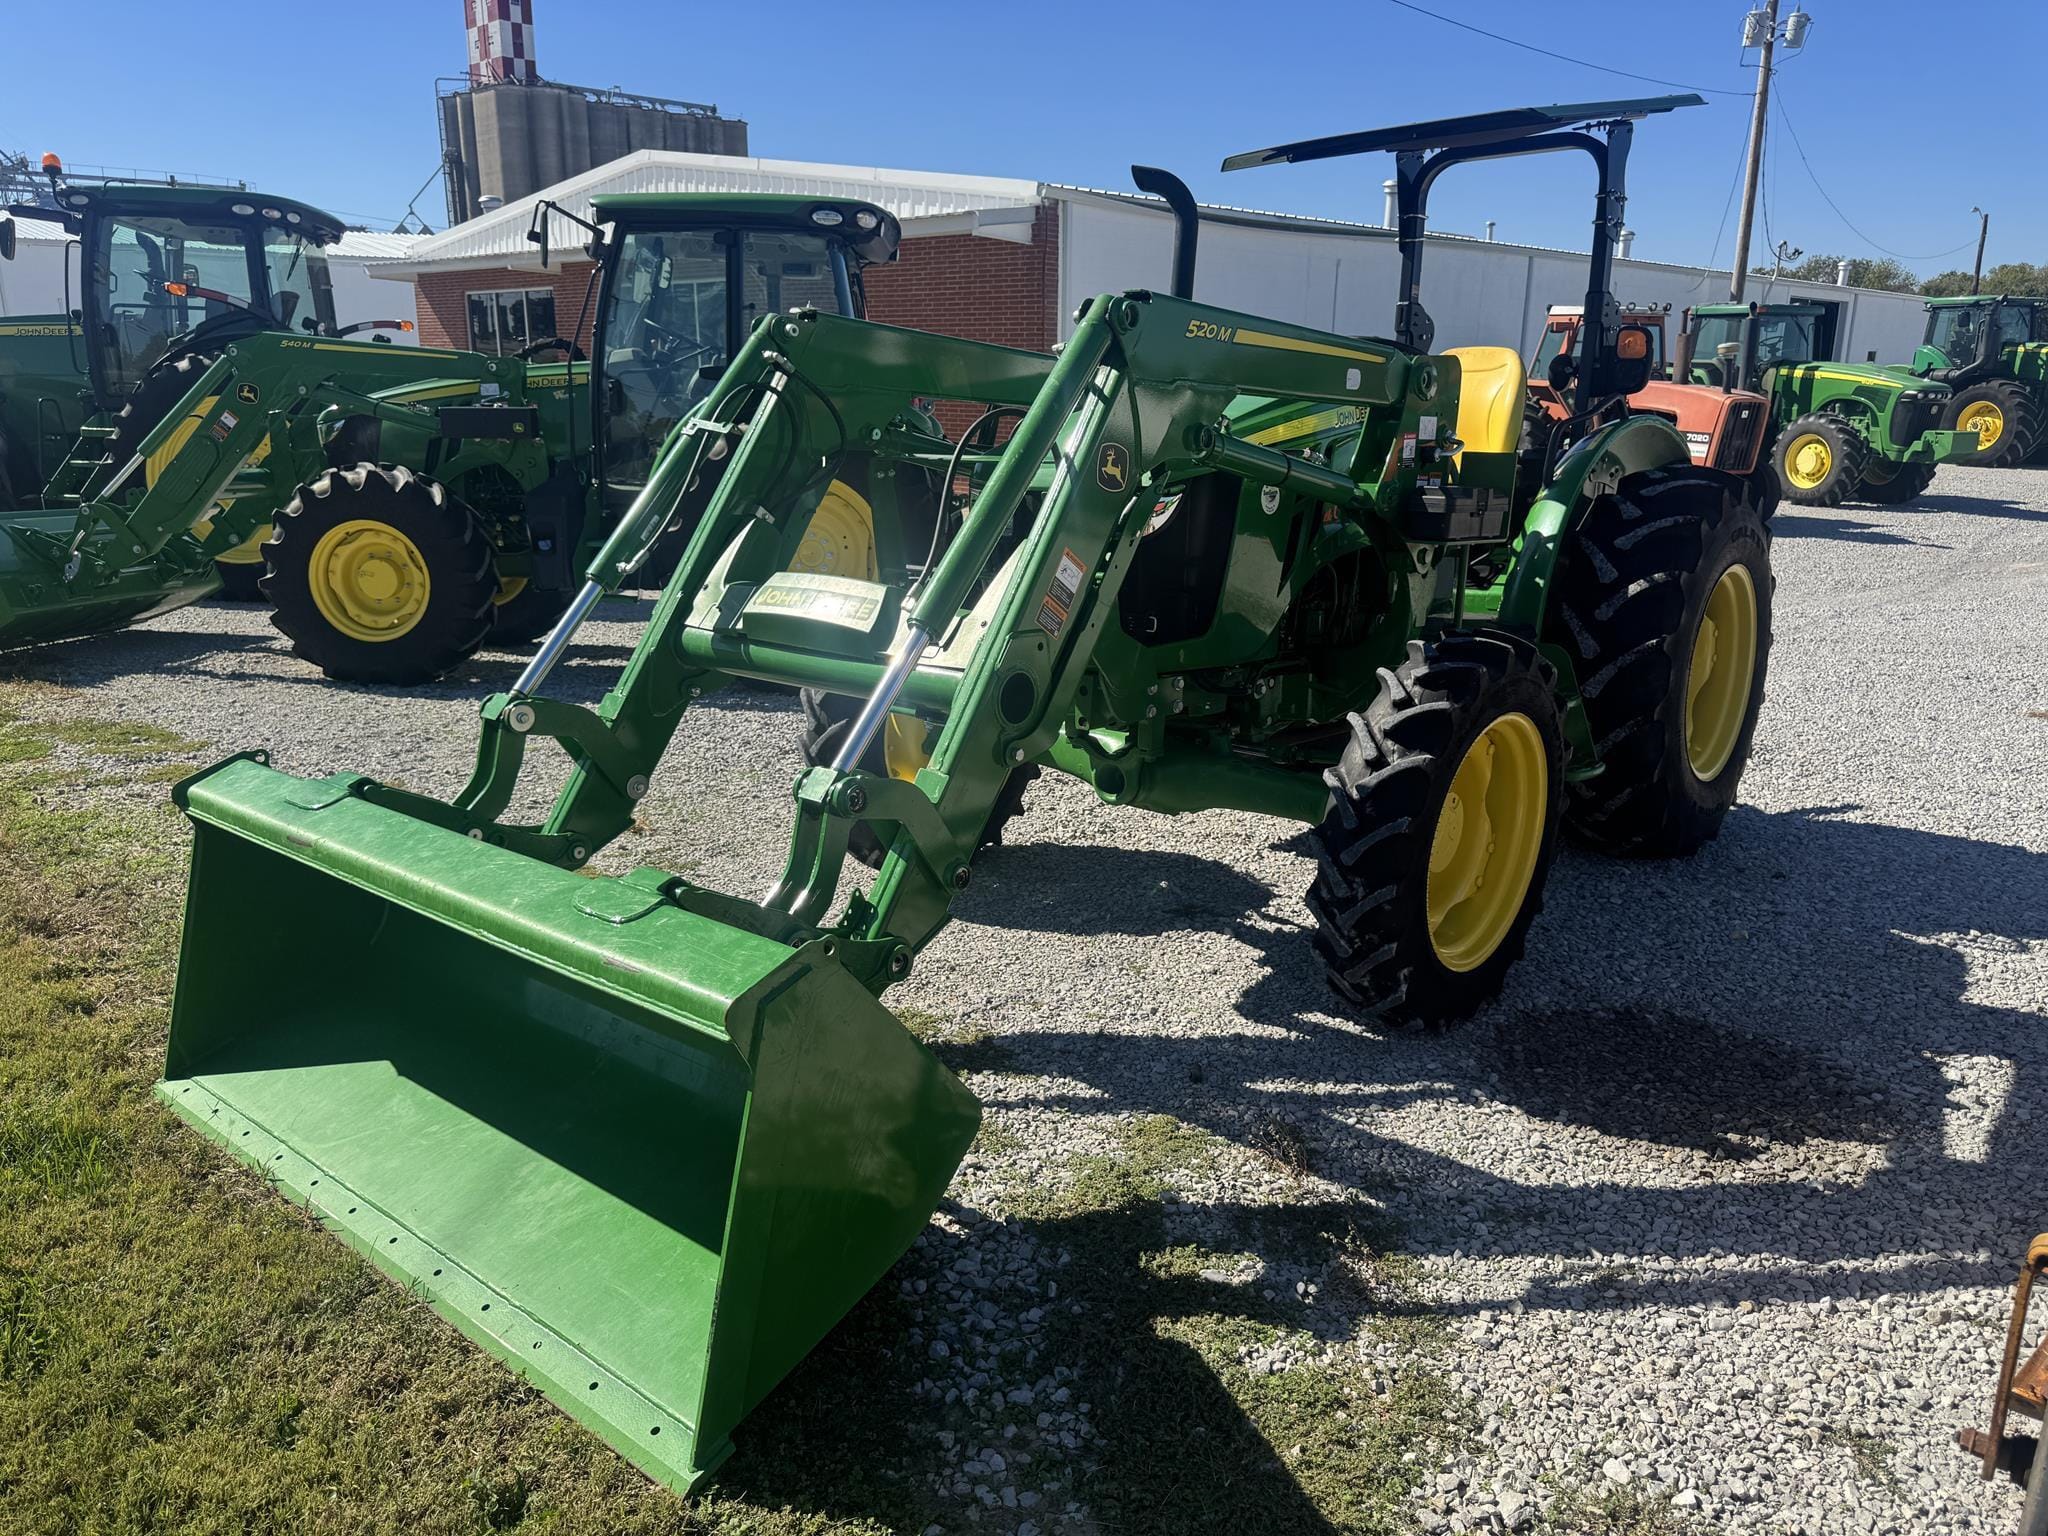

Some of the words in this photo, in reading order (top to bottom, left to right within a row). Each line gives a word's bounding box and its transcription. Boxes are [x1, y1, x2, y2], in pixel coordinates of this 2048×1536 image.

[15, 327, 42, 335] JOHN
[1185, 320, 1217, 338] 520
[1217, 326, 1232, 342] M
[280, 340, 301, 348] 540
[1334, 409, 1355, 426] JOHN
[1687, 433, 1709, 442] 7020
